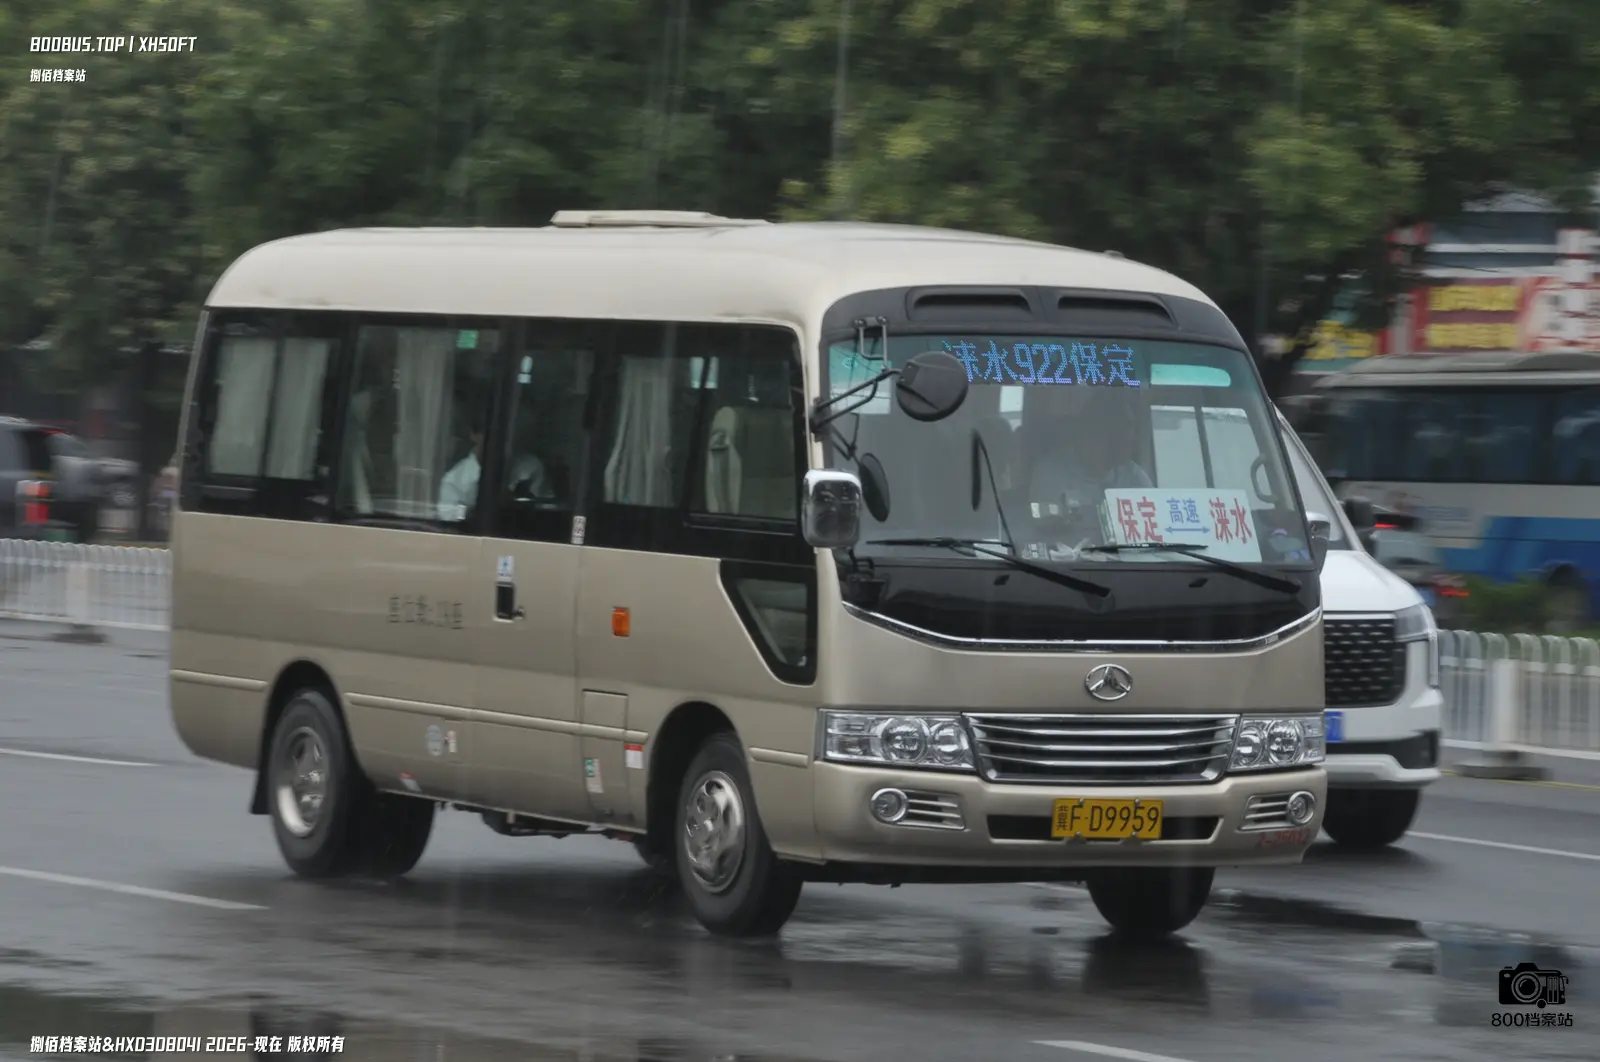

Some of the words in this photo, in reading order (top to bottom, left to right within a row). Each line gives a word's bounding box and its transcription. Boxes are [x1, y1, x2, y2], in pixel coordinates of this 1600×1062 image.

[1116, 496, 1163, 544] 保定
[1166, 497, 1201, 524] 高速
[1209, 497, 1252, 544] 涞水
